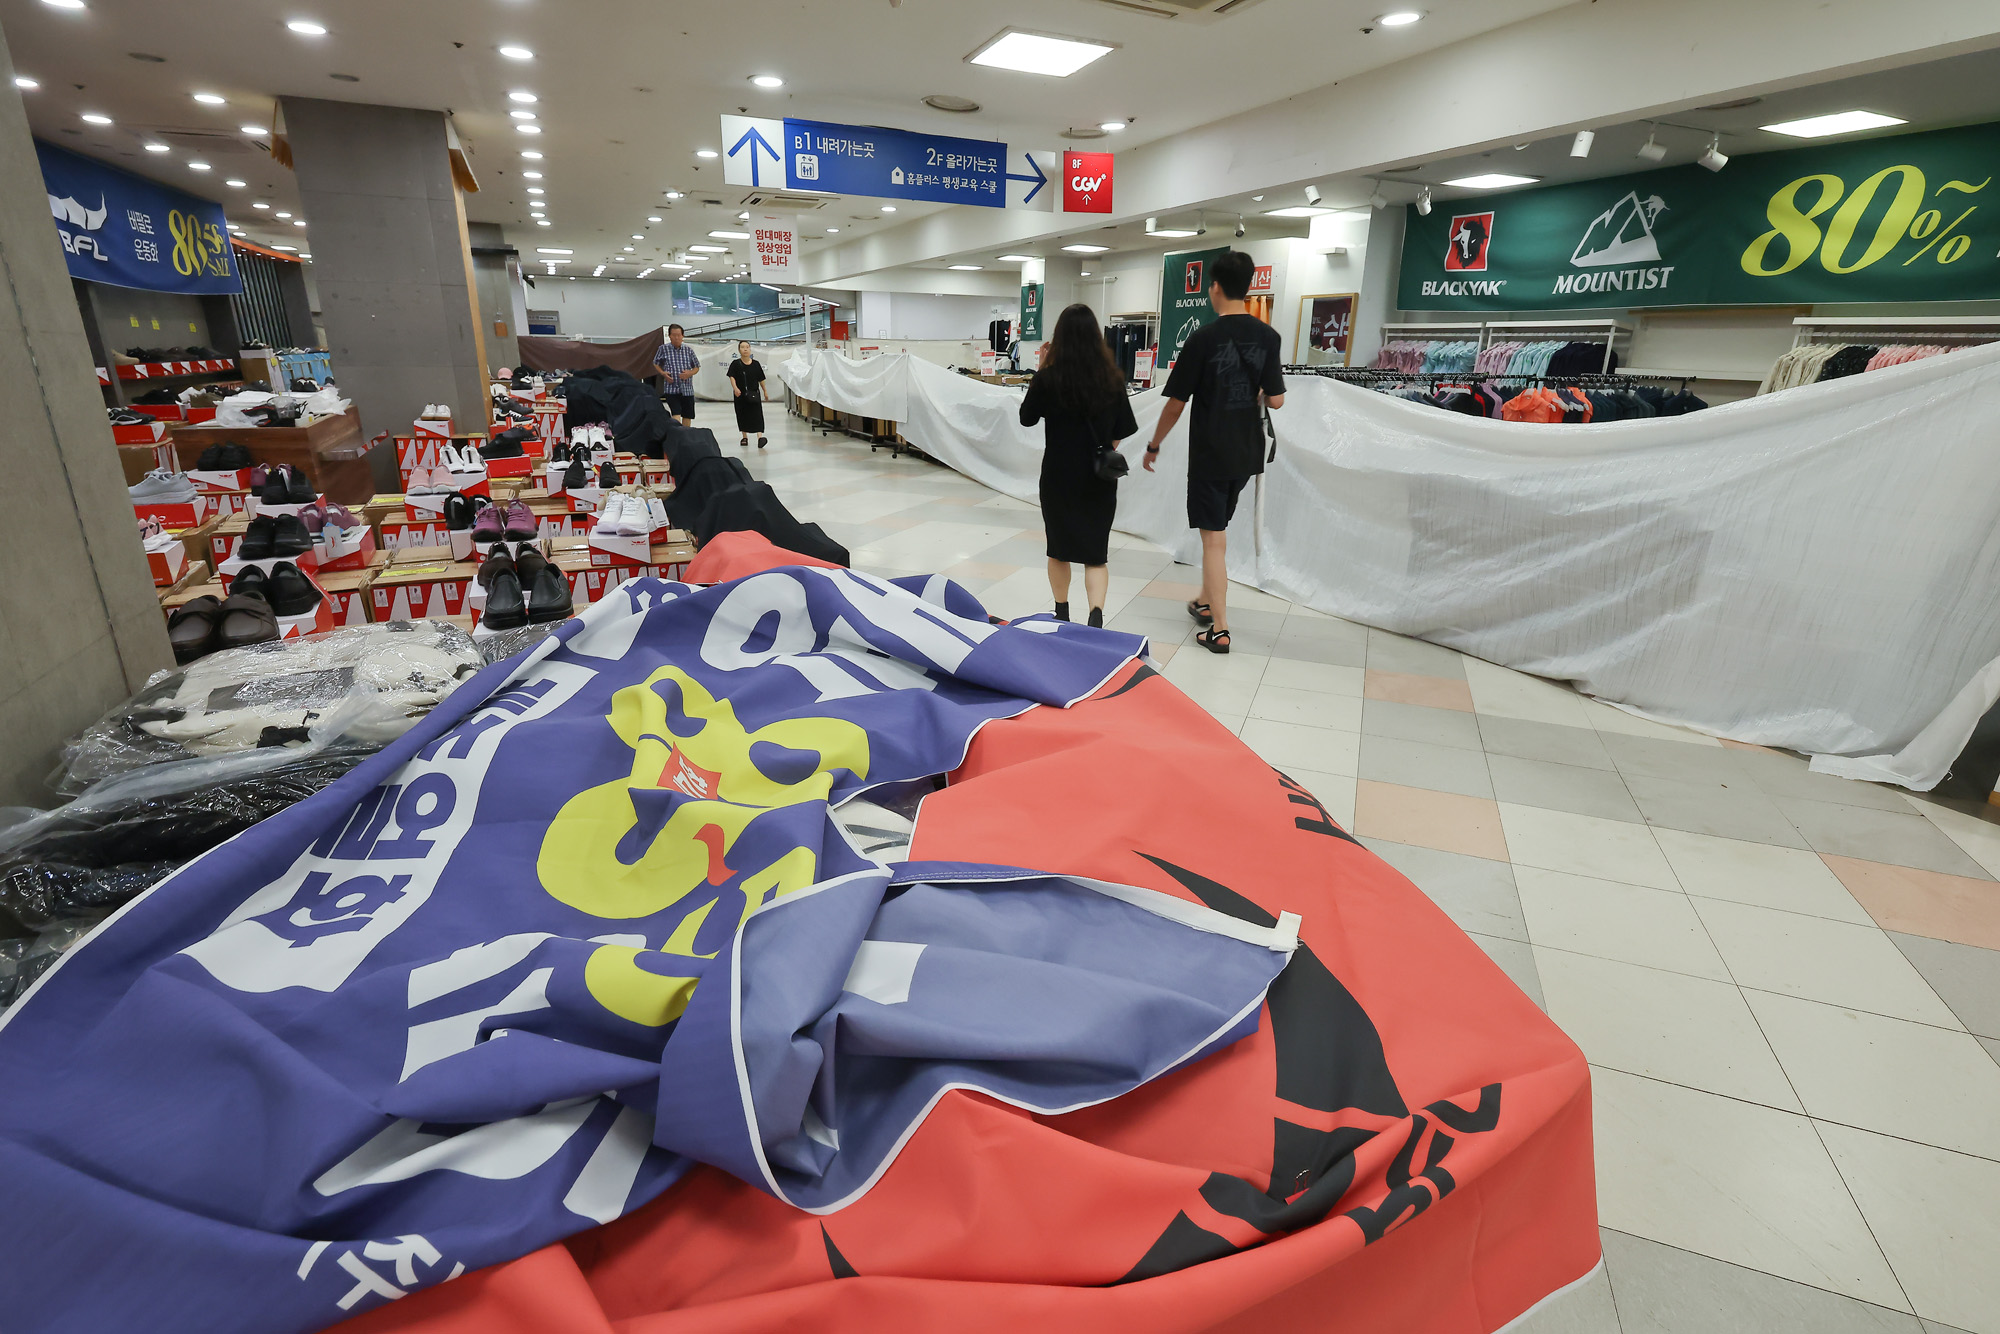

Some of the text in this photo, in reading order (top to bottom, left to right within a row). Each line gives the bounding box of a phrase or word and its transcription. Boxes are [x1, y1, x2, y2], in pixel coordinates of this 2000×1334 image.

[794, 132, 875, 159] B1 내려가는곳
[926, 147, 997, 174] 2F 올라가는곳
[1072, 159, 1082, 169] 8F
[907, 172, 997, 194] 홈플러스 평생교육 스쿨
[1071, 175, 1104, 192] CGV
[58, 228, 108, 262] BFL
[755, 229, 792, 242] 임대매장
[134, 238, 159, 263] 운동화
[756, 242, 792, 255] 정상영업
[761, 255, 788, 267] 합니다
[1551, 266, 1675, 295] MOUNTIST
